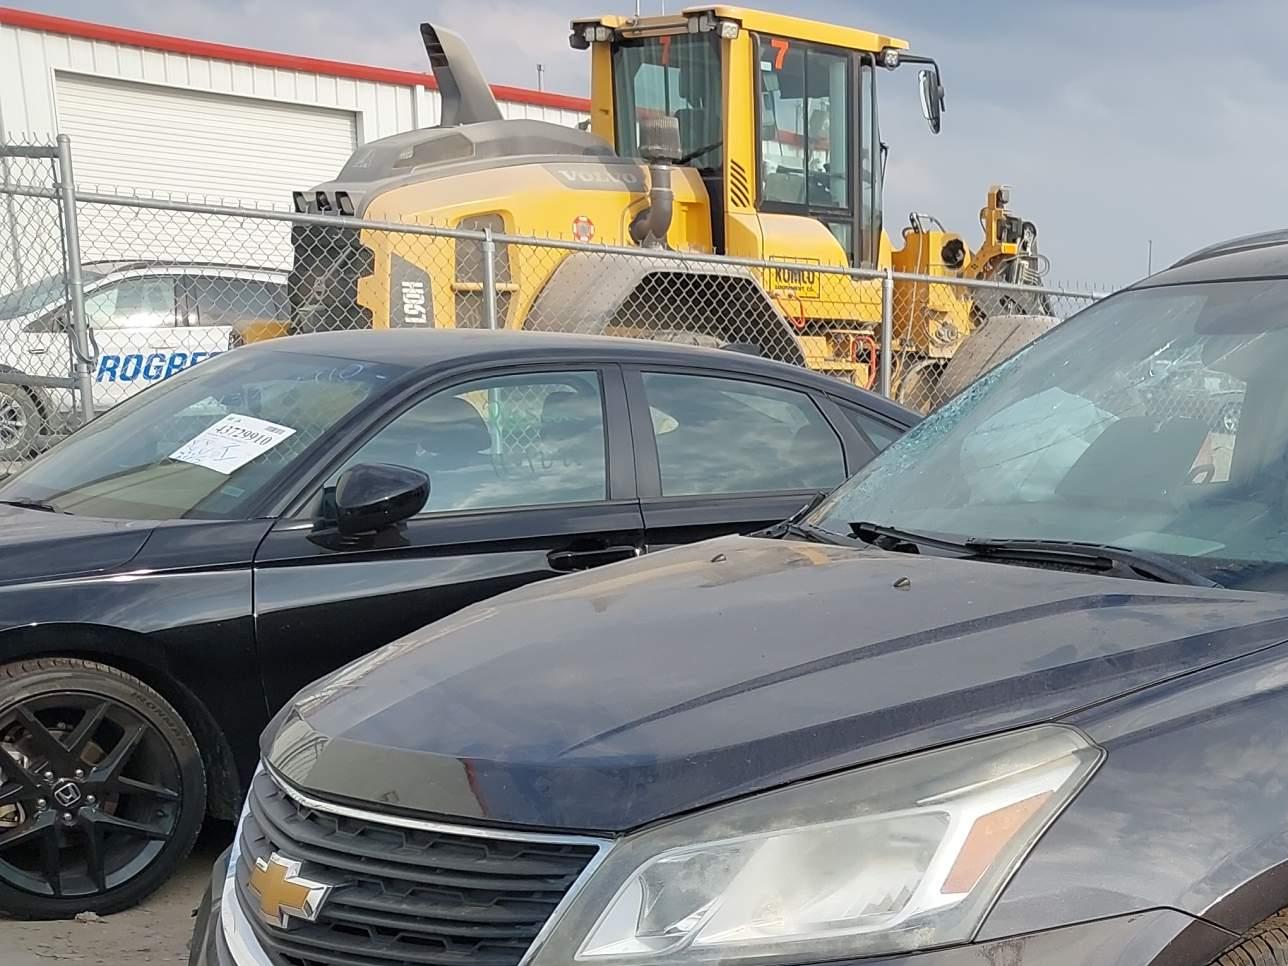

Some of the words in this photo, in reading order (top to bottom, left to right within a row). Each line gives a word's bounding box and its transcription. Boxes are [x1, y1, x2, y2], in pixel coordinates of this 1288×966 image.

[771, 38, 790, 71] 7
[557, 169, 638, 184] VOLVO
[401, 281, 427, 323] L90H
[215, 425, 273, 446] 43729910
